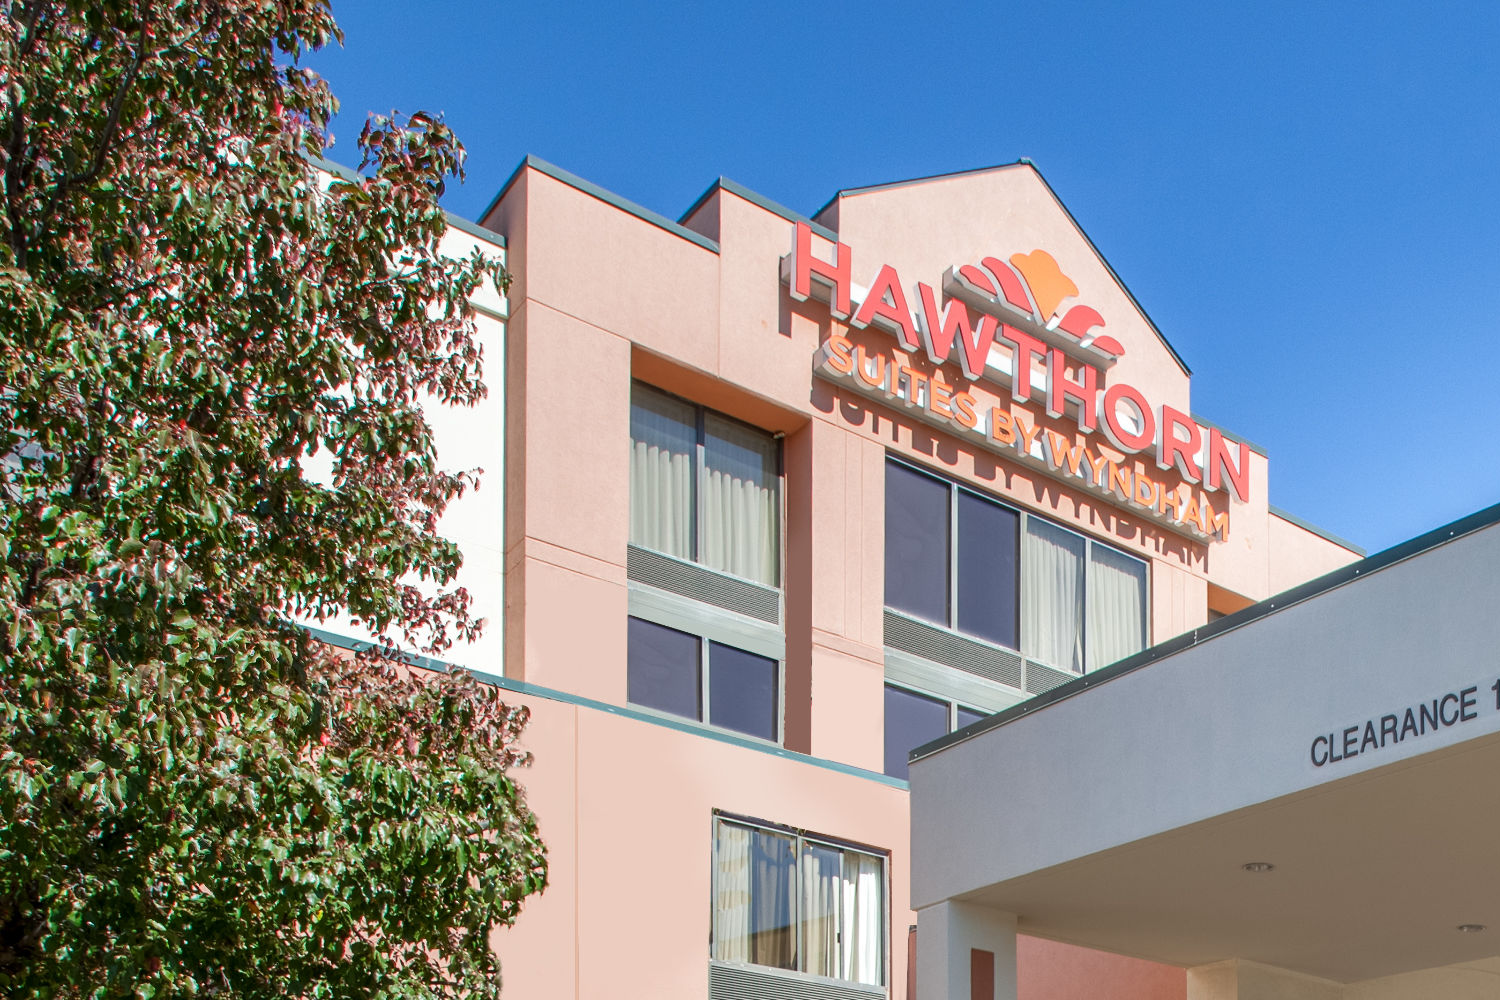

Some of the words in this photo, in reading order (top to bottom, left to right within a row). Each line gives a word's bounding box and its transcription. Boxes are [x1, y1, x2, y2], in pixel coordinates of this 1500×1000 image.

[791, 220, 1250, 503] HAWTHORN
[820, 334, 978, 432] SUITES
[987, 404, 1041, 457] BY
[1042, 436, 1230, 544] WYNDHAM
[1310, 685, 1478, 768] CLEARANCE
